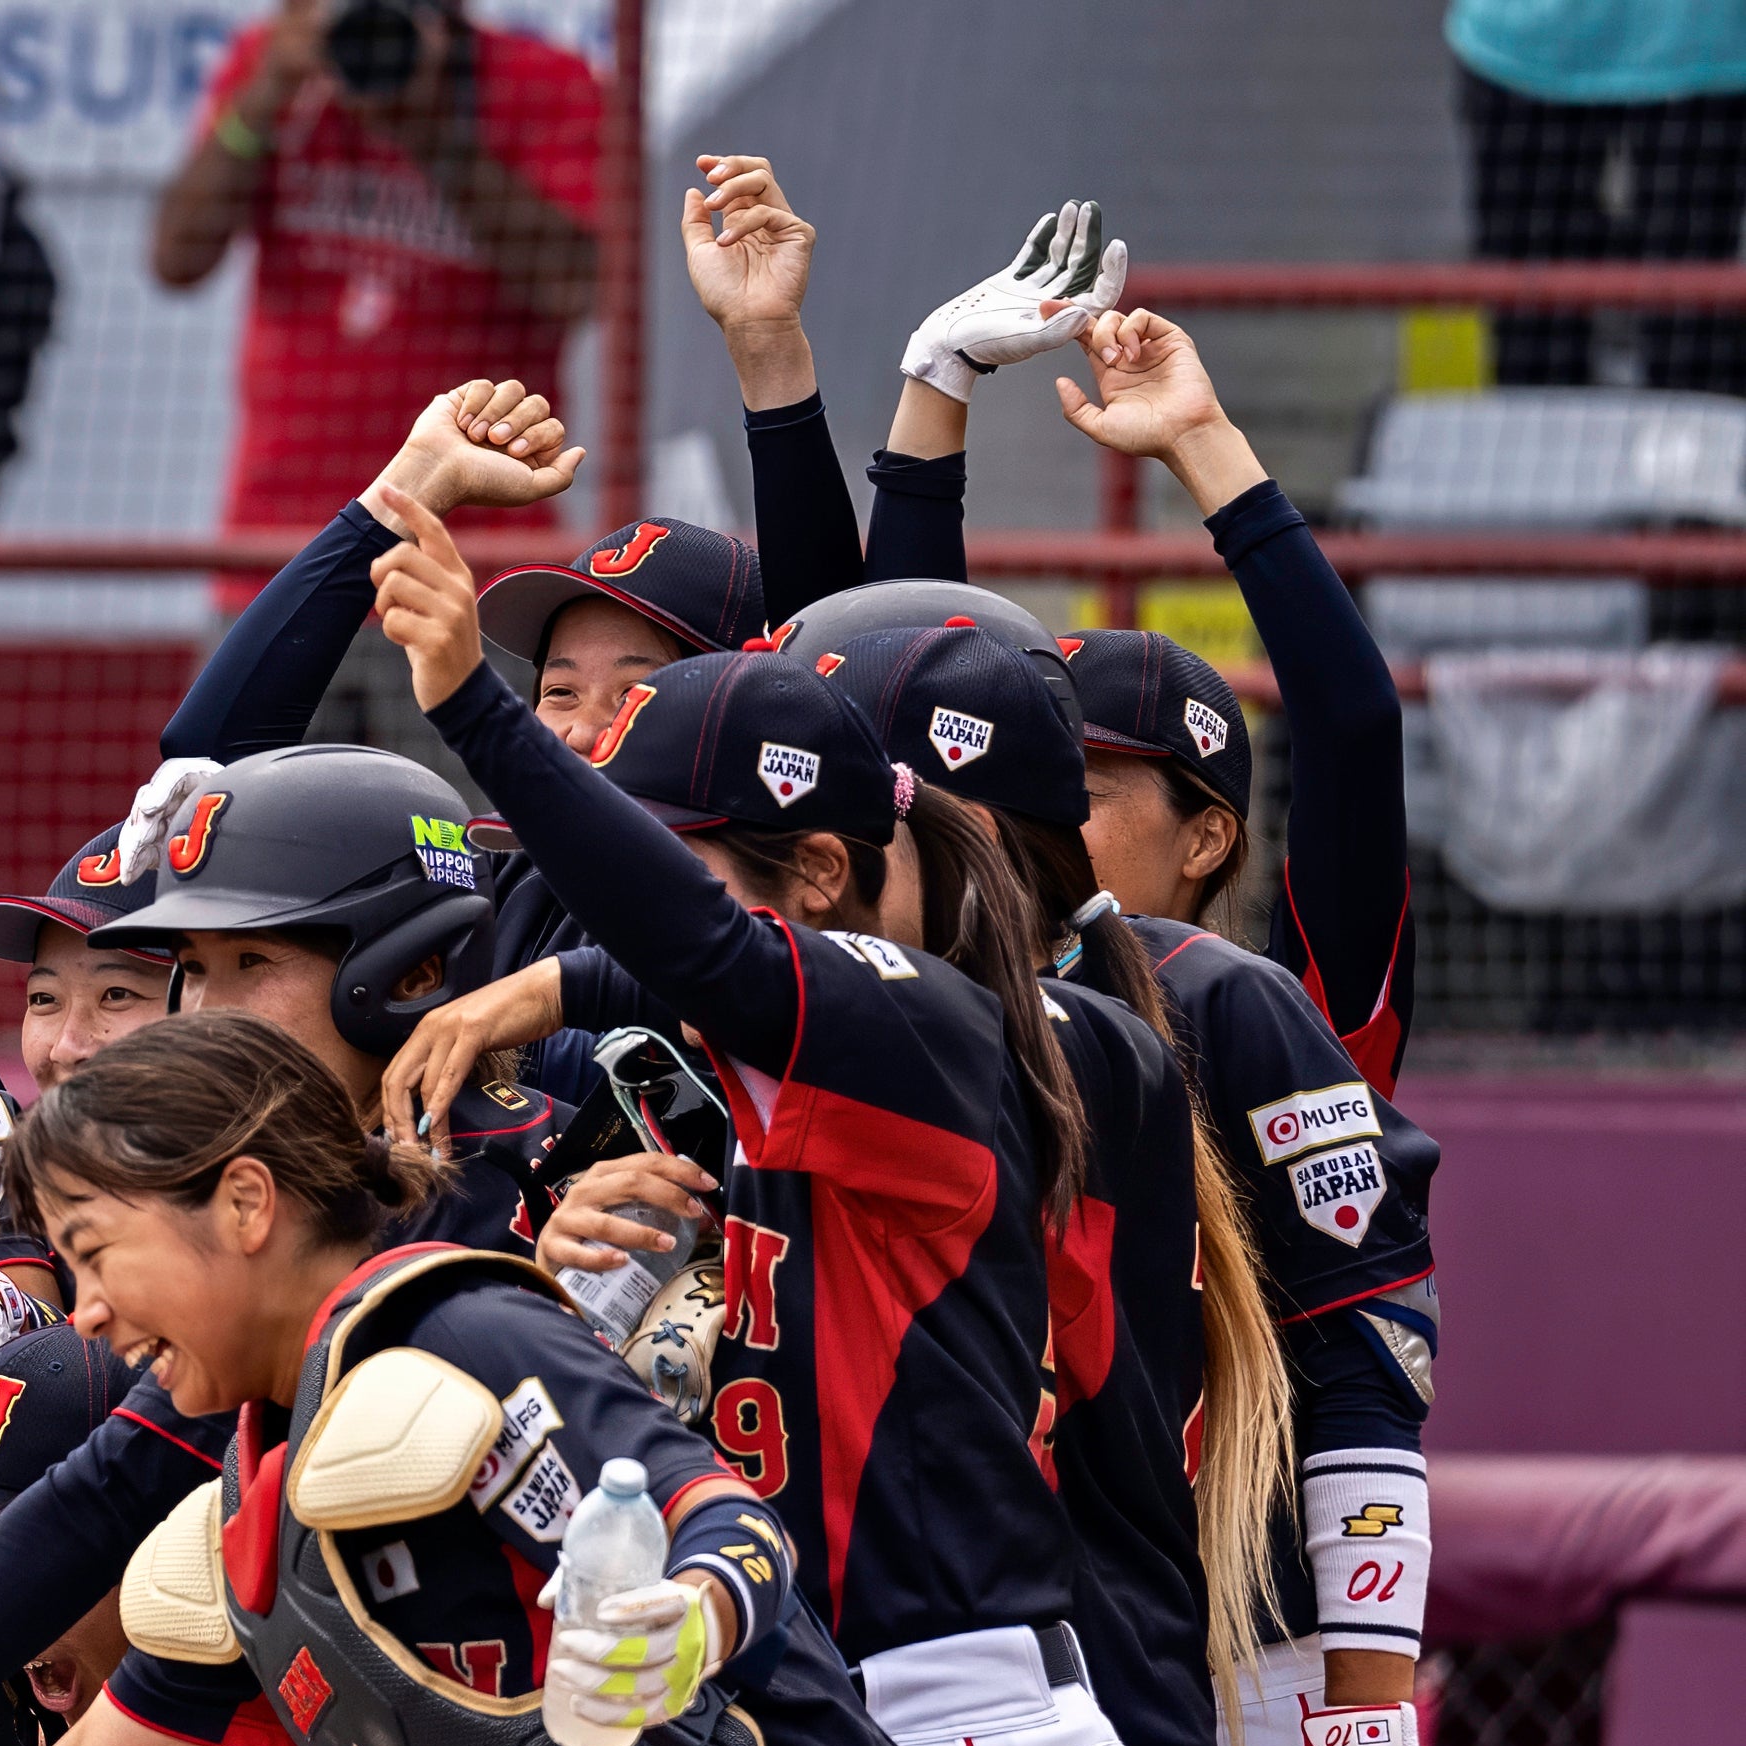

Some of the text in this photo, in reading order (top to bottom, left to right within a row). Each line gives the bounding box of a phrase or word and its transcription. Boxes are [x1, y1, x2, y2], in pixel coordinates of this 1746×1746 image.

[589, 523, 670, 578] J
[589, 683, 658, 769] J
[933, 723, 986, 750] JAPAN
[937, 712, 989, 735] SAMURAI
[763, 759, 814, 784] JAPAN
[167, 792, 228, 877] J
[411, 815, 471, 856] NX
[424, 864, 476, 890] XPRESS
[1301, 1100, 1369, 1129] MUFG
[1296, 1150, 1374, 1186] SAMURAI
[1303, 1166, 1380, 1210] JAPAN
